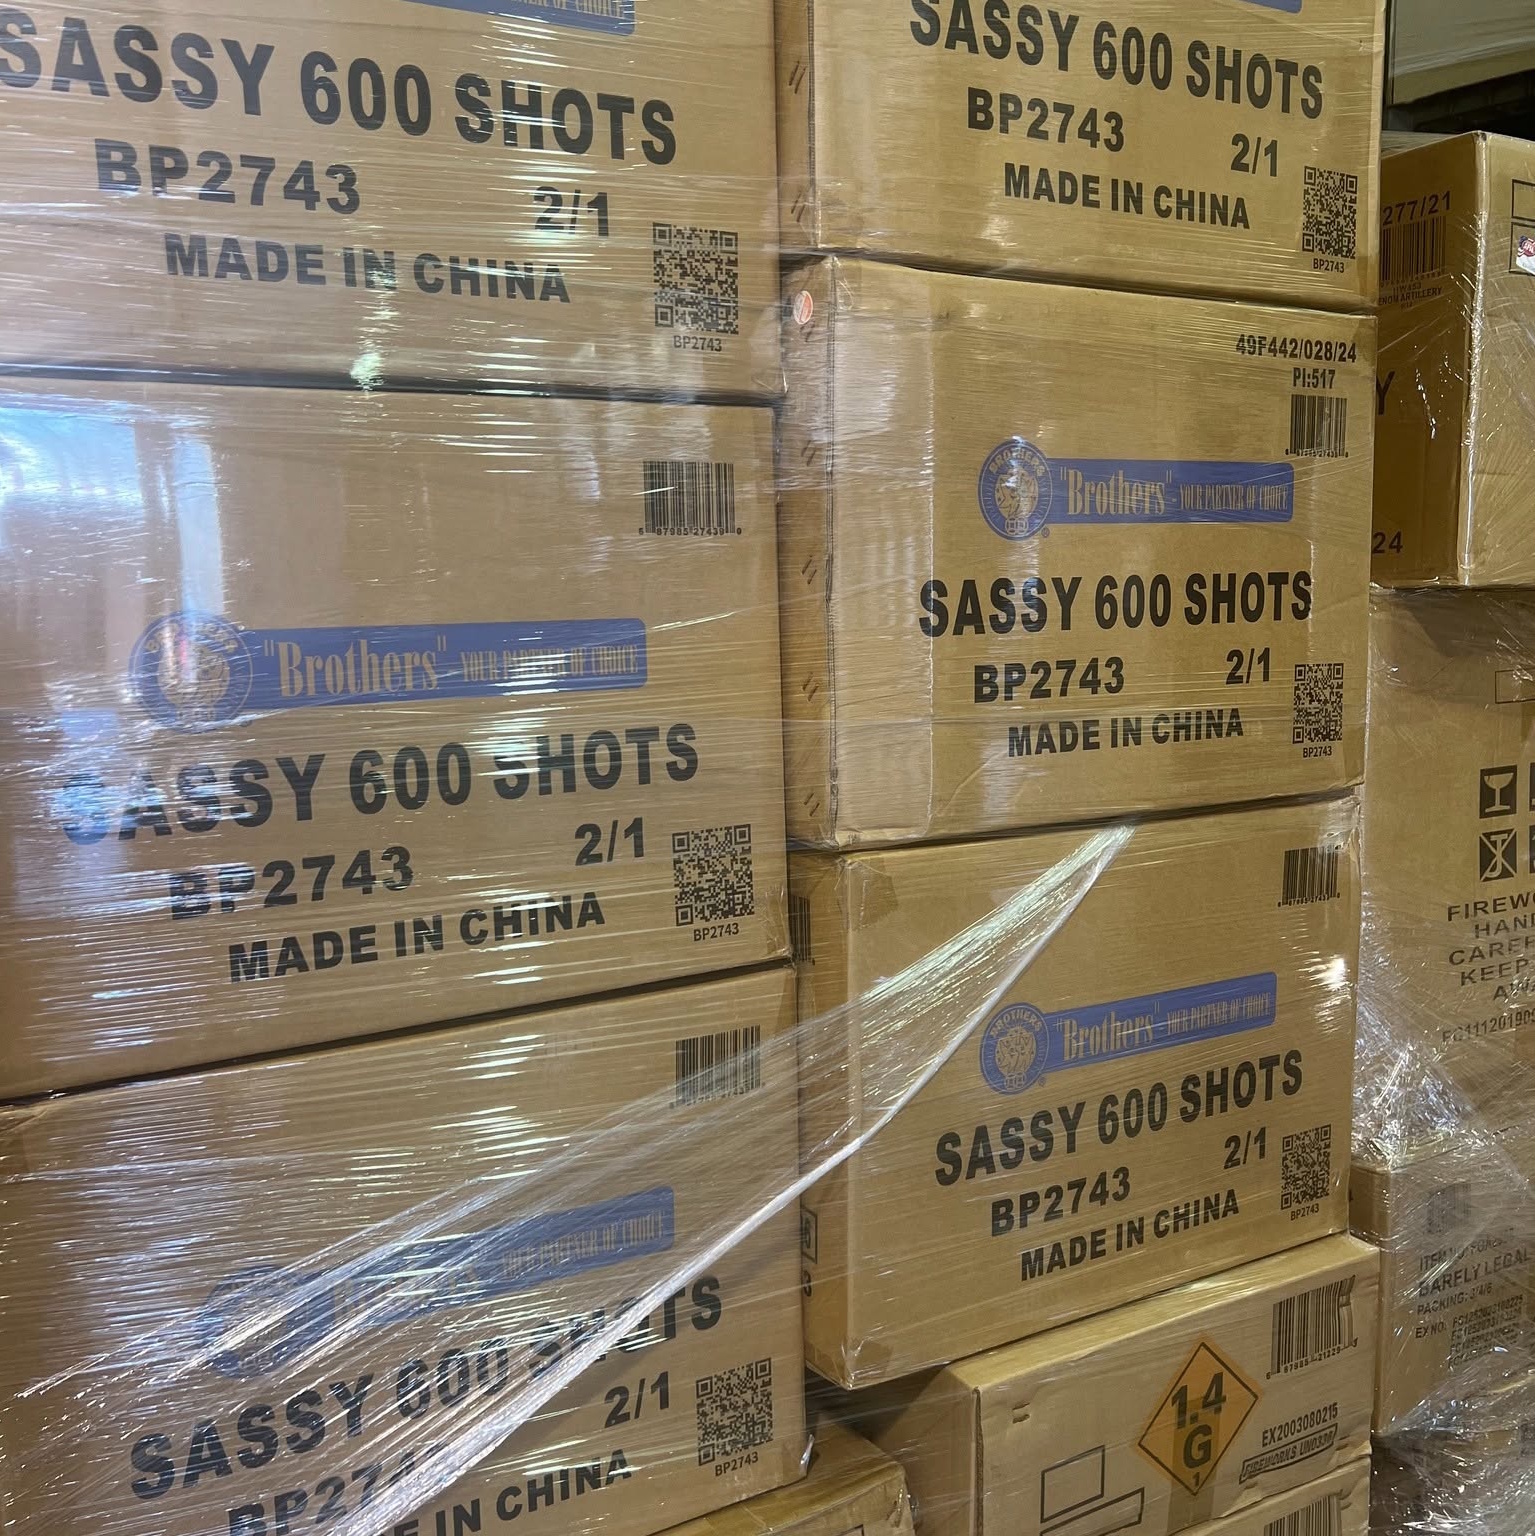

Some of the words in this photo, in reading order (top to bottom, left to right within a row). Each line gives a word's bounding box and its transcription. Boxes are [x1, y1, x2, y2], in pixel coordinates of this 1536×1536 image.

[0, 9, 275, 116] SASSY
[300, 50, 432, 137] 600
[454, 72, 678, 166] SHOTS
[910, 0, 1083, 72] SASSY
[1093, 20, 1173, 93] 600
[1185, 40, 1324, 120] SHOTS
[967, 86, 1126, 154] BP2743
[1231, 132, 1279, 178] 2/1
[94, 138, 362, 215] BP2743
[534, 185, 610, 238] 2/1
[1003, 162, 1103, 212] MADE
[1110, 176, 1144, 216] IN
[1153, 184, 1251, 231] CHINA
[164, 233, 326, 287] MADE
[343, 246, 397, 290] IN
[413, 252, 572, 305] CHINA
[1311, 257, 1346, 275] BP2743
[672, 334, 724, 353] BP2743
[1235, 333, 1358, 364] 49F442/028/24
[1292, 366, 1336, 390] PI:517
[1180, 484, 1203, 511] YOUR
[1205, 484, 1244, 511] PARTNER
[1246, 484, 1258, 511] OF
[1259, 485, 1289, 512] CHOICE
[918, 576, 1083, 639] SASSY
[1094, 573, 1172, 631] 600
[1184, 570, 1313, 627] SHOTS
[461, 651, 499, 682] YOUR
[570, 646, 587, 677] OF
[591, 644, 639, 675] CHOICE
[973, 656, 1125, 704] BP2743
[1225, 648, 1271, 686] 2/1
[1009, 716, 1101, 758] MADE
[1111, 712, 1142, 748] IN
[1152, 707, 1244, 745] CHINA
[1302, 746, 1333, 759] BP2743
[62, 752, 326, 846] SASSY
[349, 742, 472, 816] 600
[494, 723, 699, 801] SHOTS
[169, 846, 415, 922] BP2743
[574, 817, 646, 867] 2/1
[229, 925, 380, 984] MADE
[395, 918, 445, 959] IN
[459, 891, 606, 946] CHINA
[692, 922, 740, 942] BP2743
[1460, 958, 1530, 987] KEEP
[935, 1100, 1087, 1187] SASSY
[1098, 1082, 1166, 1144] 600
[1180, 1049, 1303, 1123] SHOTS
[991, 1166, 1131, 1237] BP2743
[1224, 1126, 1268, 1170] 2/1
[1021, 1230, 1107, 1282] MADE
[1116, 1217, 1145, 1252] IN
[1153, 1188, 1240, 1239] CHINA
[1290, 1203, 1320, 1221] BP2743
[131, 1372, 374, 1500] SASSY
[396, 1338, 510, 1420] 600
[605, 1371, 671, 1429] 2/1
[1171, 1372, 1226, 1429] 1.4
[1262, 1402, 1338, 1448] EX2003080215
[714, 1451, 760, 1477] BP2743
[1183, 1424, 1212, 1469] G
[436, 1498, 482, 1536] IN
[496, 1448, 633, 1522] CHINA
[1192, 1472, 1200, 1487] 1
